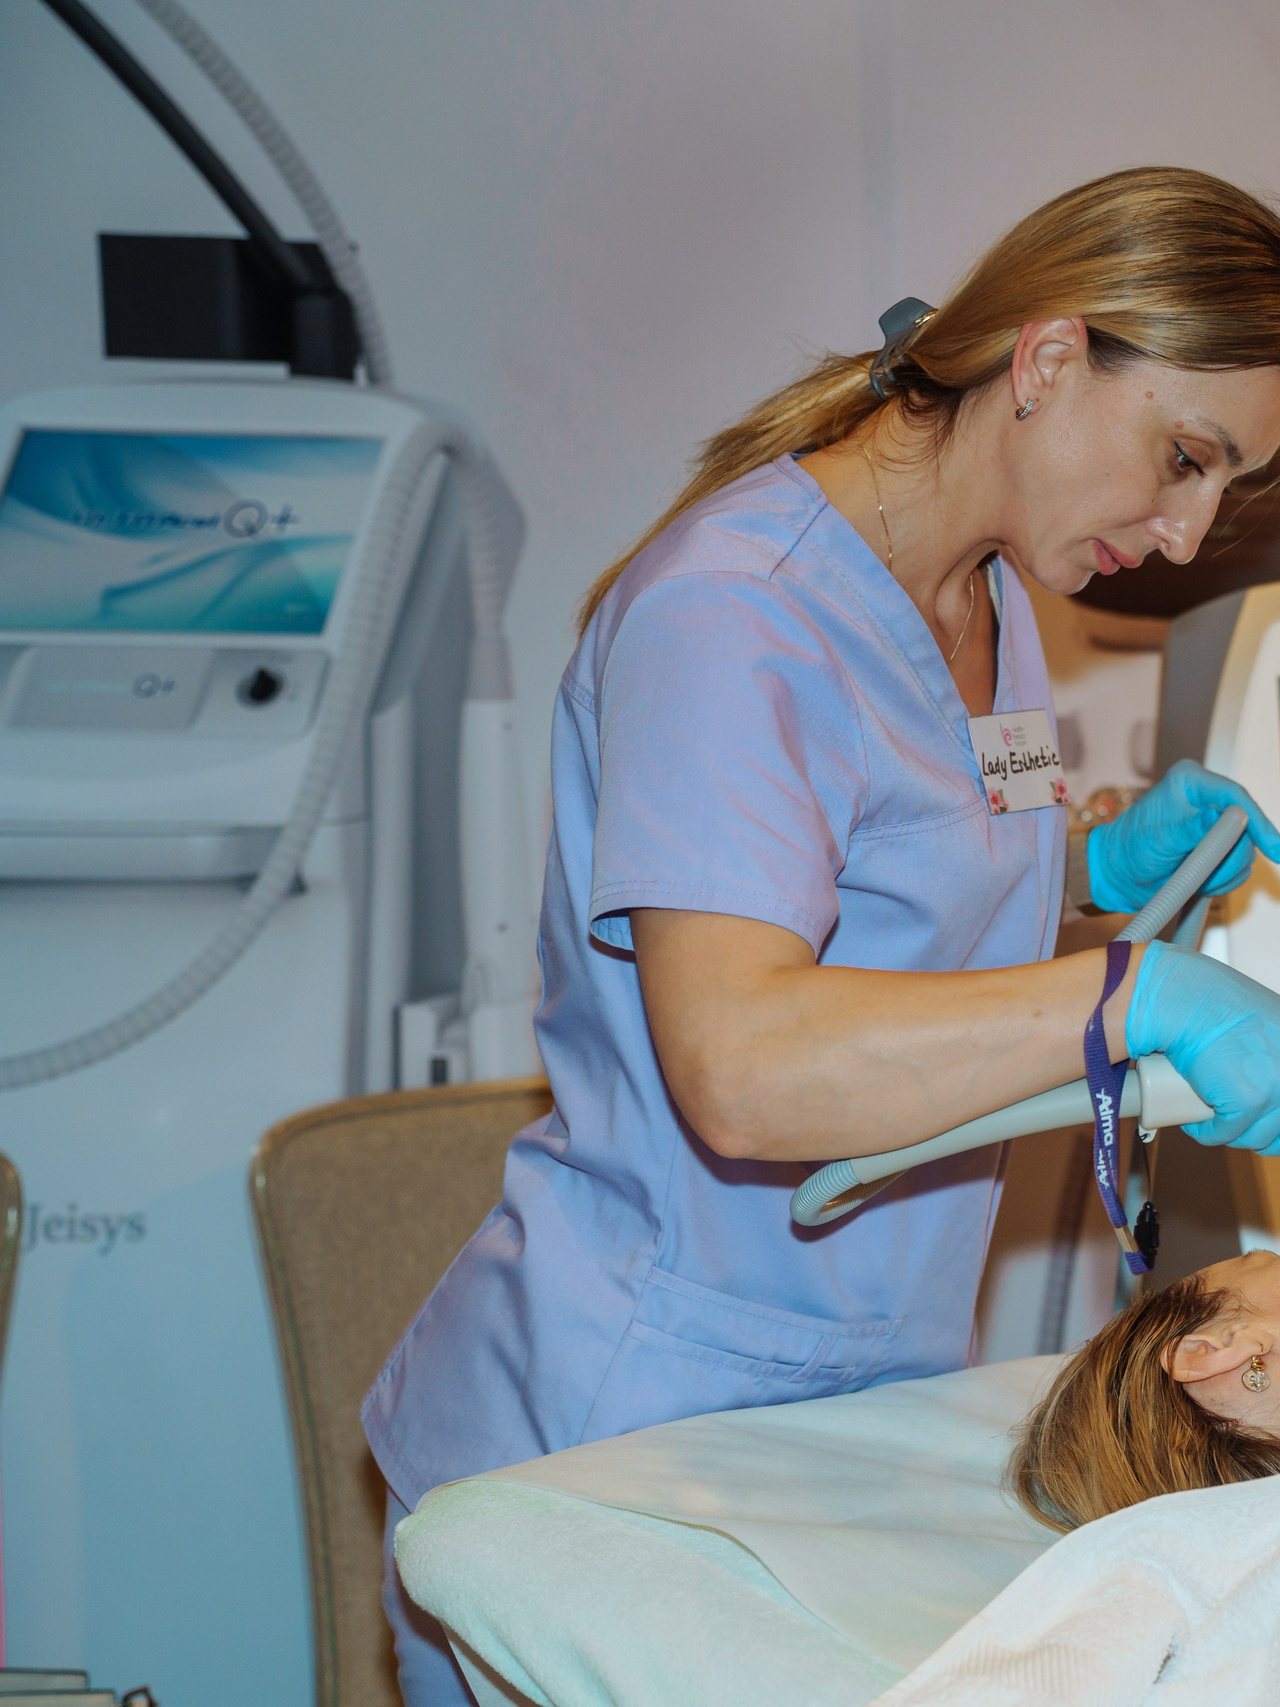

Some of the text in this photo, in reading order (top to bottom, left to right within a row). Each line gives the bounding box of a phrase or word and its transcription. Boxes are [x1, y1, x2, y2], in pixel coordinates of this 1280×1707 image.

[981, 752, 1008, 781] Lady
[1096, 1088, 1114, 1147] Alma
[24, 1203, 147, 1256] Jeisys
